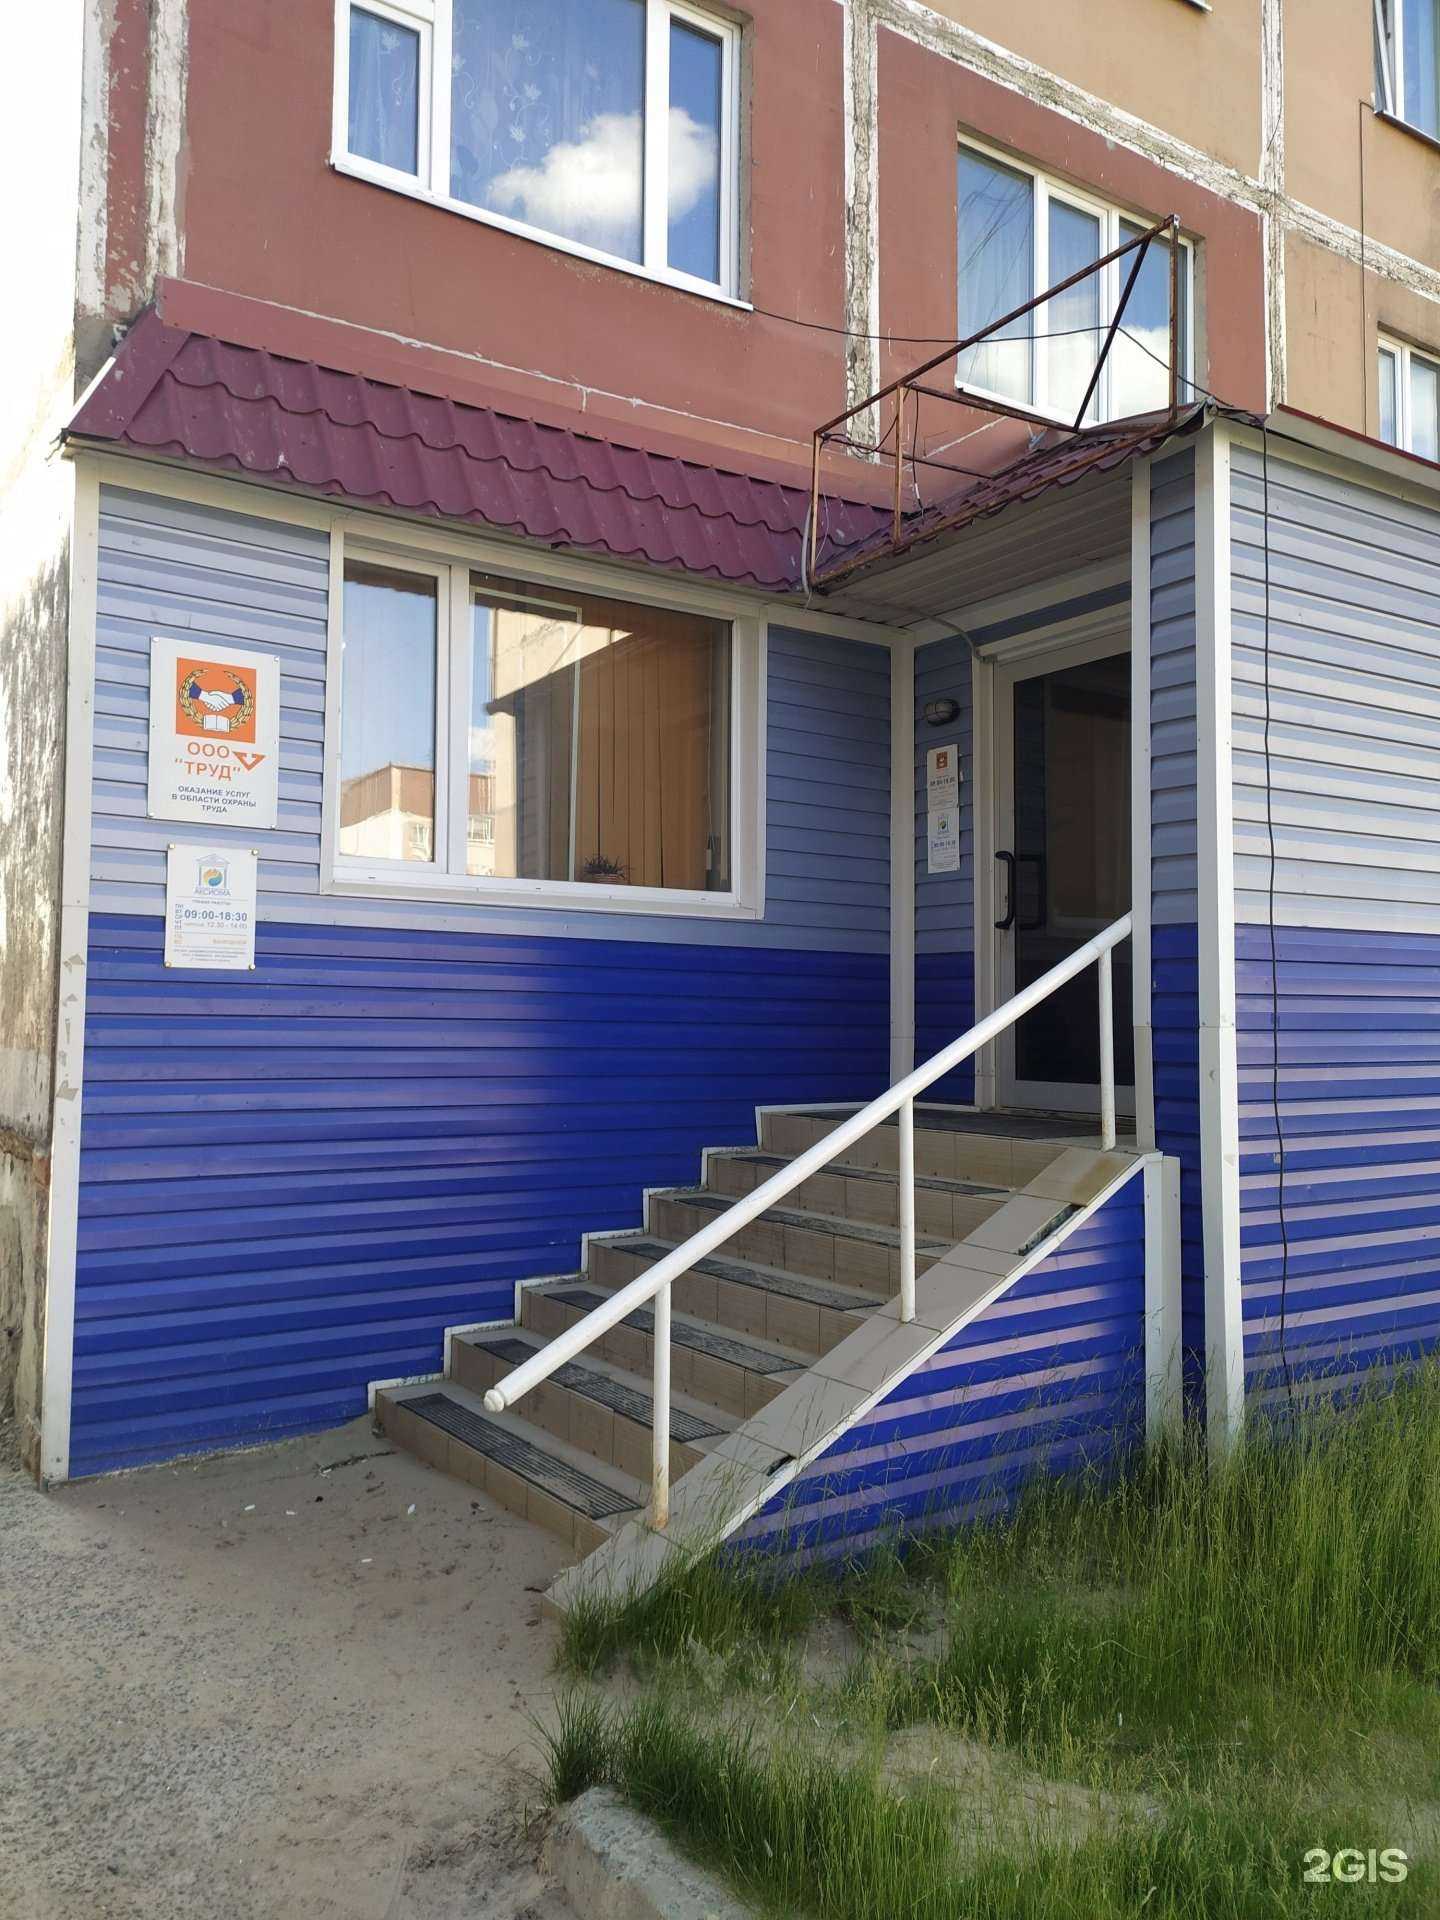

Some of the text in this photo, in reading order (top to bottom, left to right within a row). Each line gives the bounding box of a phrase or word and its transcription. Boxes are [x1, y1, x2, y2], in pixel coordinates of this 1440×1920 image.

[187, 742, 230, 758] ООО
[175, 759, 240, 781] "ТРУД"
[178, 785, 251, 799] ОКАЗАНИЕ УСЛУГ
[180, 794, 220, 804] ОБЛАСТИ
[221, 798, 257, 808] ОХРАНЫ
[201, 804, 228, 813] ТРУДА
[184, 909, 248, 922] 09:00-18:30
